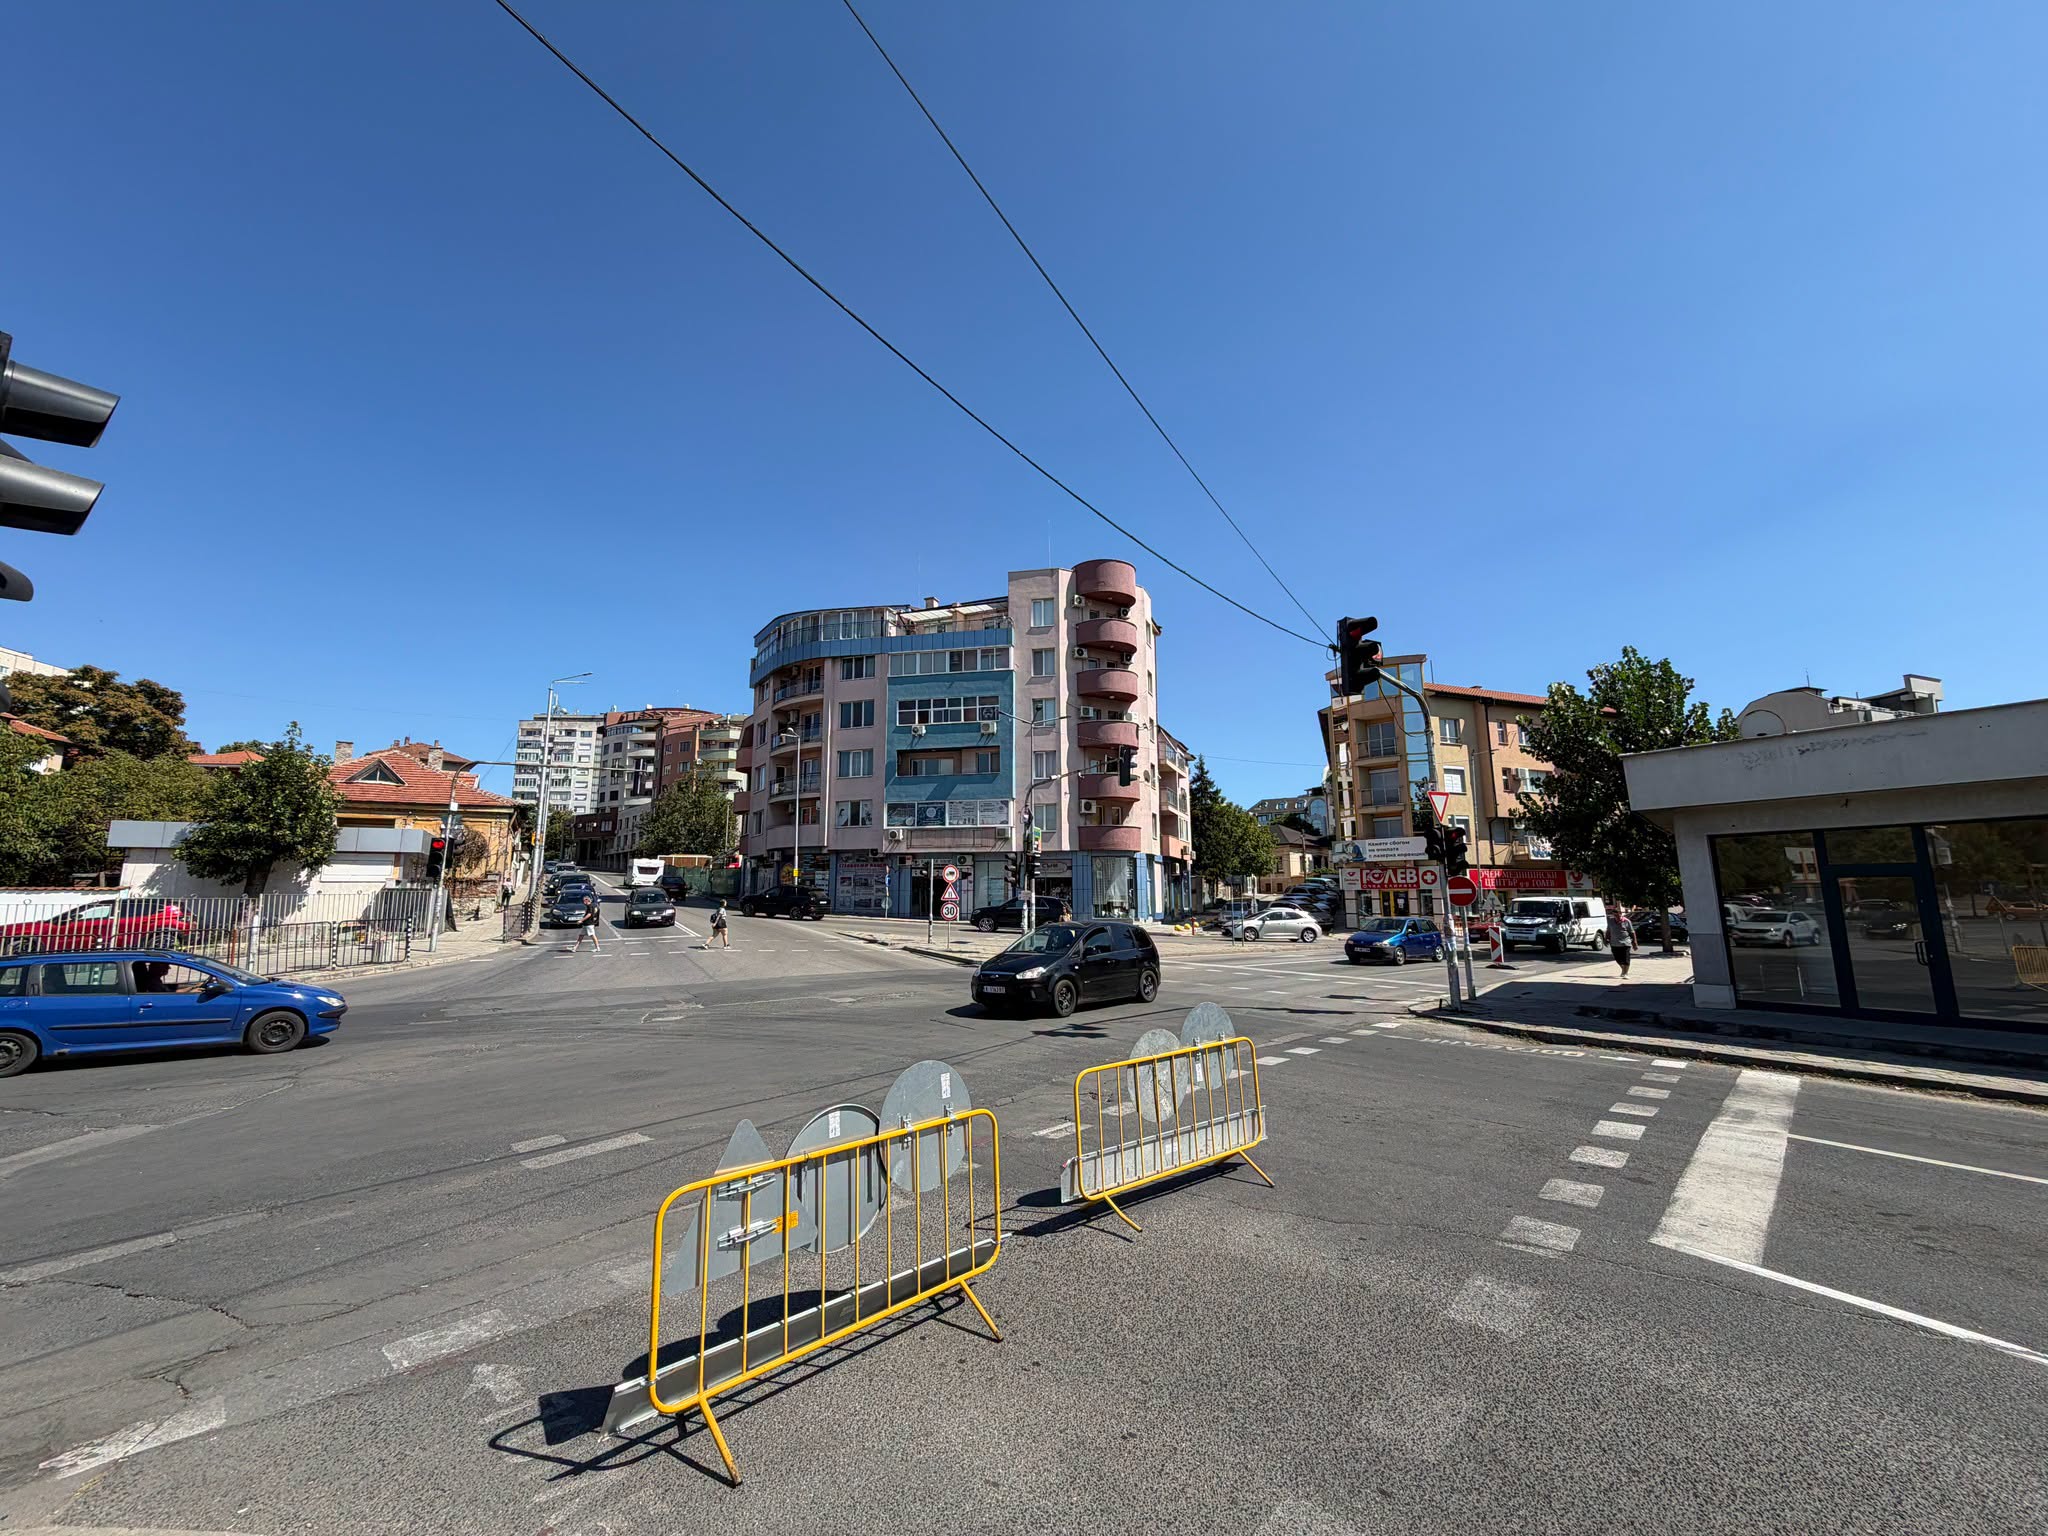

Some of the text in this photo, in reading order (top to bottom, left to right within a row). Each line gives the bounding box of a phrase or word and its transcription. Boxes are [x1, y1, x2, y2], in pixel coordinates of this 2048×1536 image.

[1362, 868, 1418, 884] ГОЛЕВ
[1485, 878, 1518, 887] ЦЕНТЪР
[1532, 879, 1554, 887] ГОЛЕВ
[944, 906, 955, 916] 30
